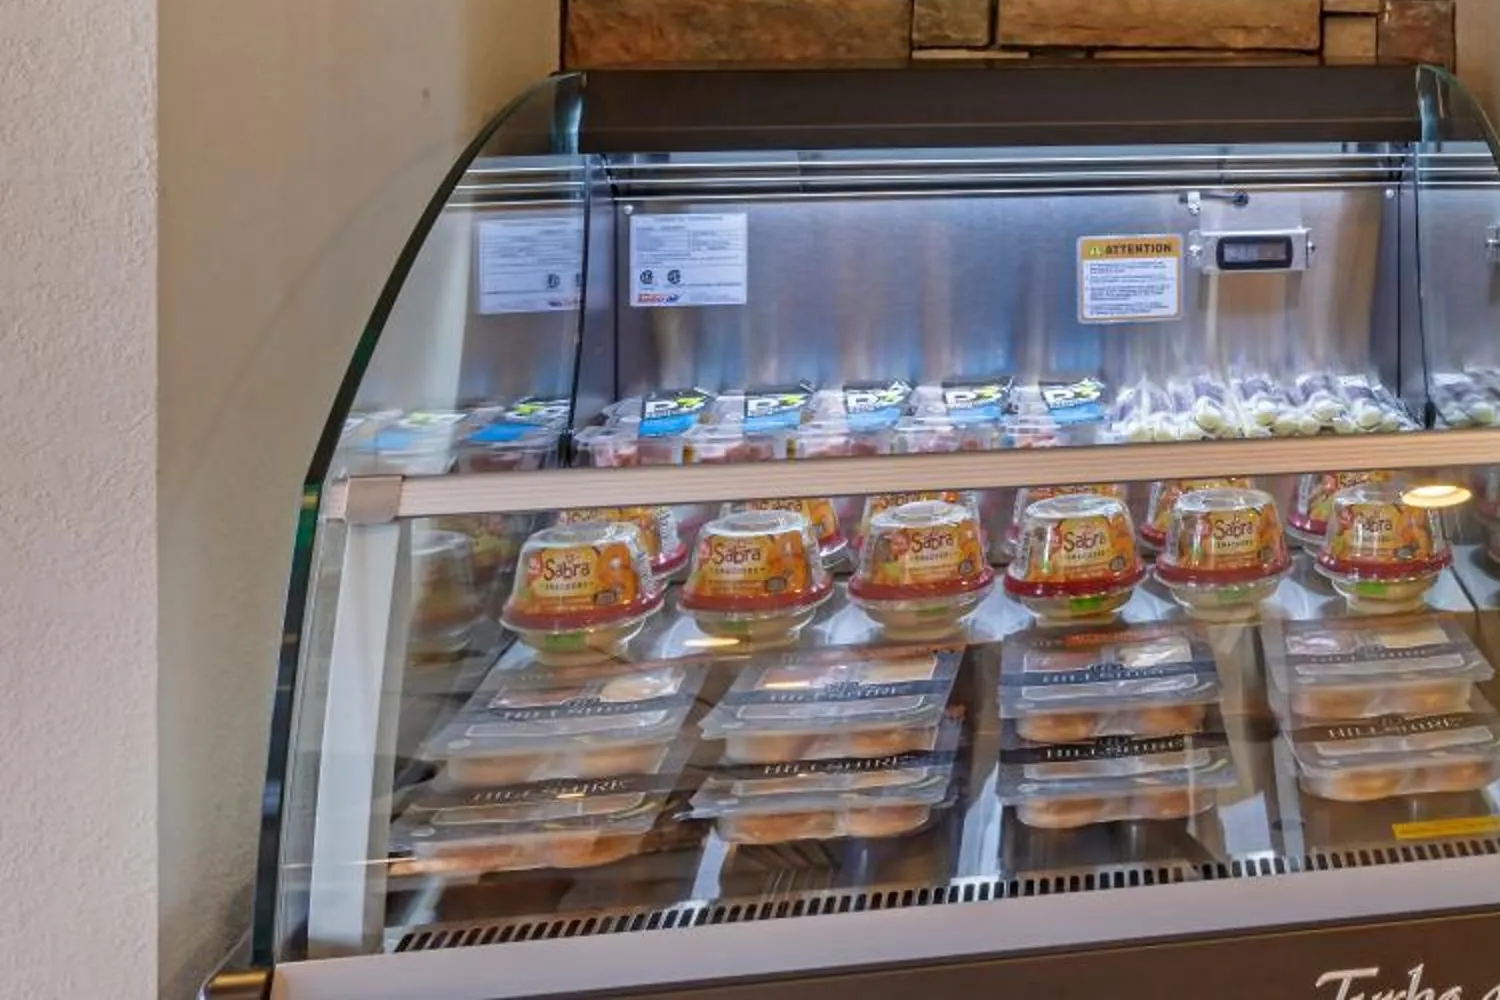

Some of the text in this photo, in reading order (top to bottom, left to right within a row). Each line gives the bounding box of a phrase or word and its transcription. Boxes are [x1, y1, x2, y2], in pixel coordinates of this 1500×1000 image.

[1105, 243, 1172, 255] ATTENTION
[1214, 519, 1253, 540] Sabra
[714, 541, 761, 565] Sabra
[911, 531, 954, 553] Sabra
[1063, 531, 1105, 553] Sabra
[543, 558, 590, 581] Sabra
